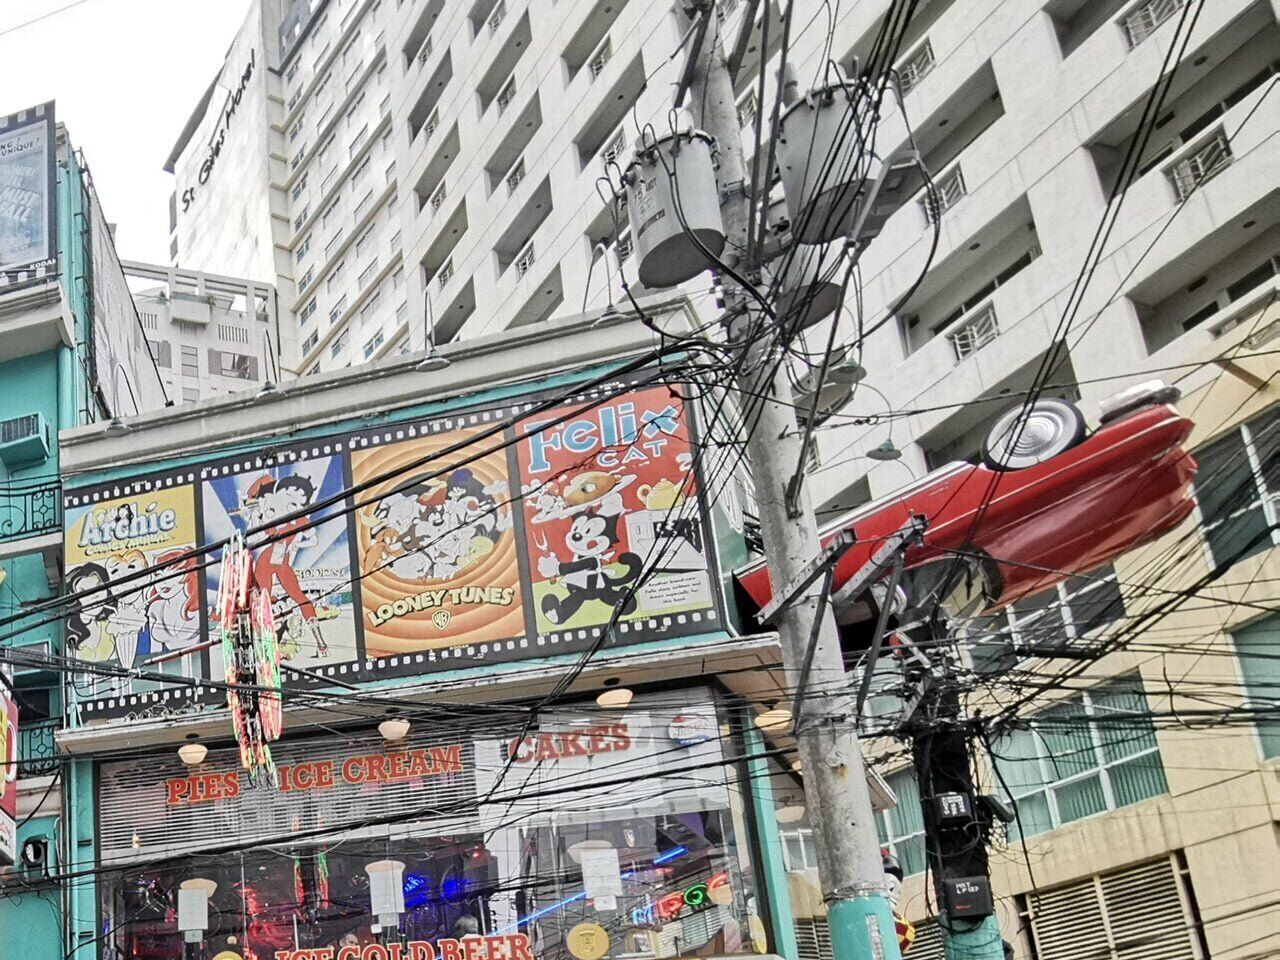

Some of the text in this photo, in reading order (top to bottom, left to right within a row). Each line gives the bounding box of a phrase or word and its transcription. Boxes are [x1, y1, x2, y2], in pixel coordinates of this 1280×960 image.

[523, 402, 680, 474] Felix
[596, 439, 668, 467] CAT
[78, 501, 176, 548] Archie
[367, 586, 515, 628] LOONEY TUNES
[166, 771, 239, 805] PIES
[277, 760, 335, 792] ICE
[341, 745, 465, 785] CREAM
[507, 723, 632, 764] CAKES
